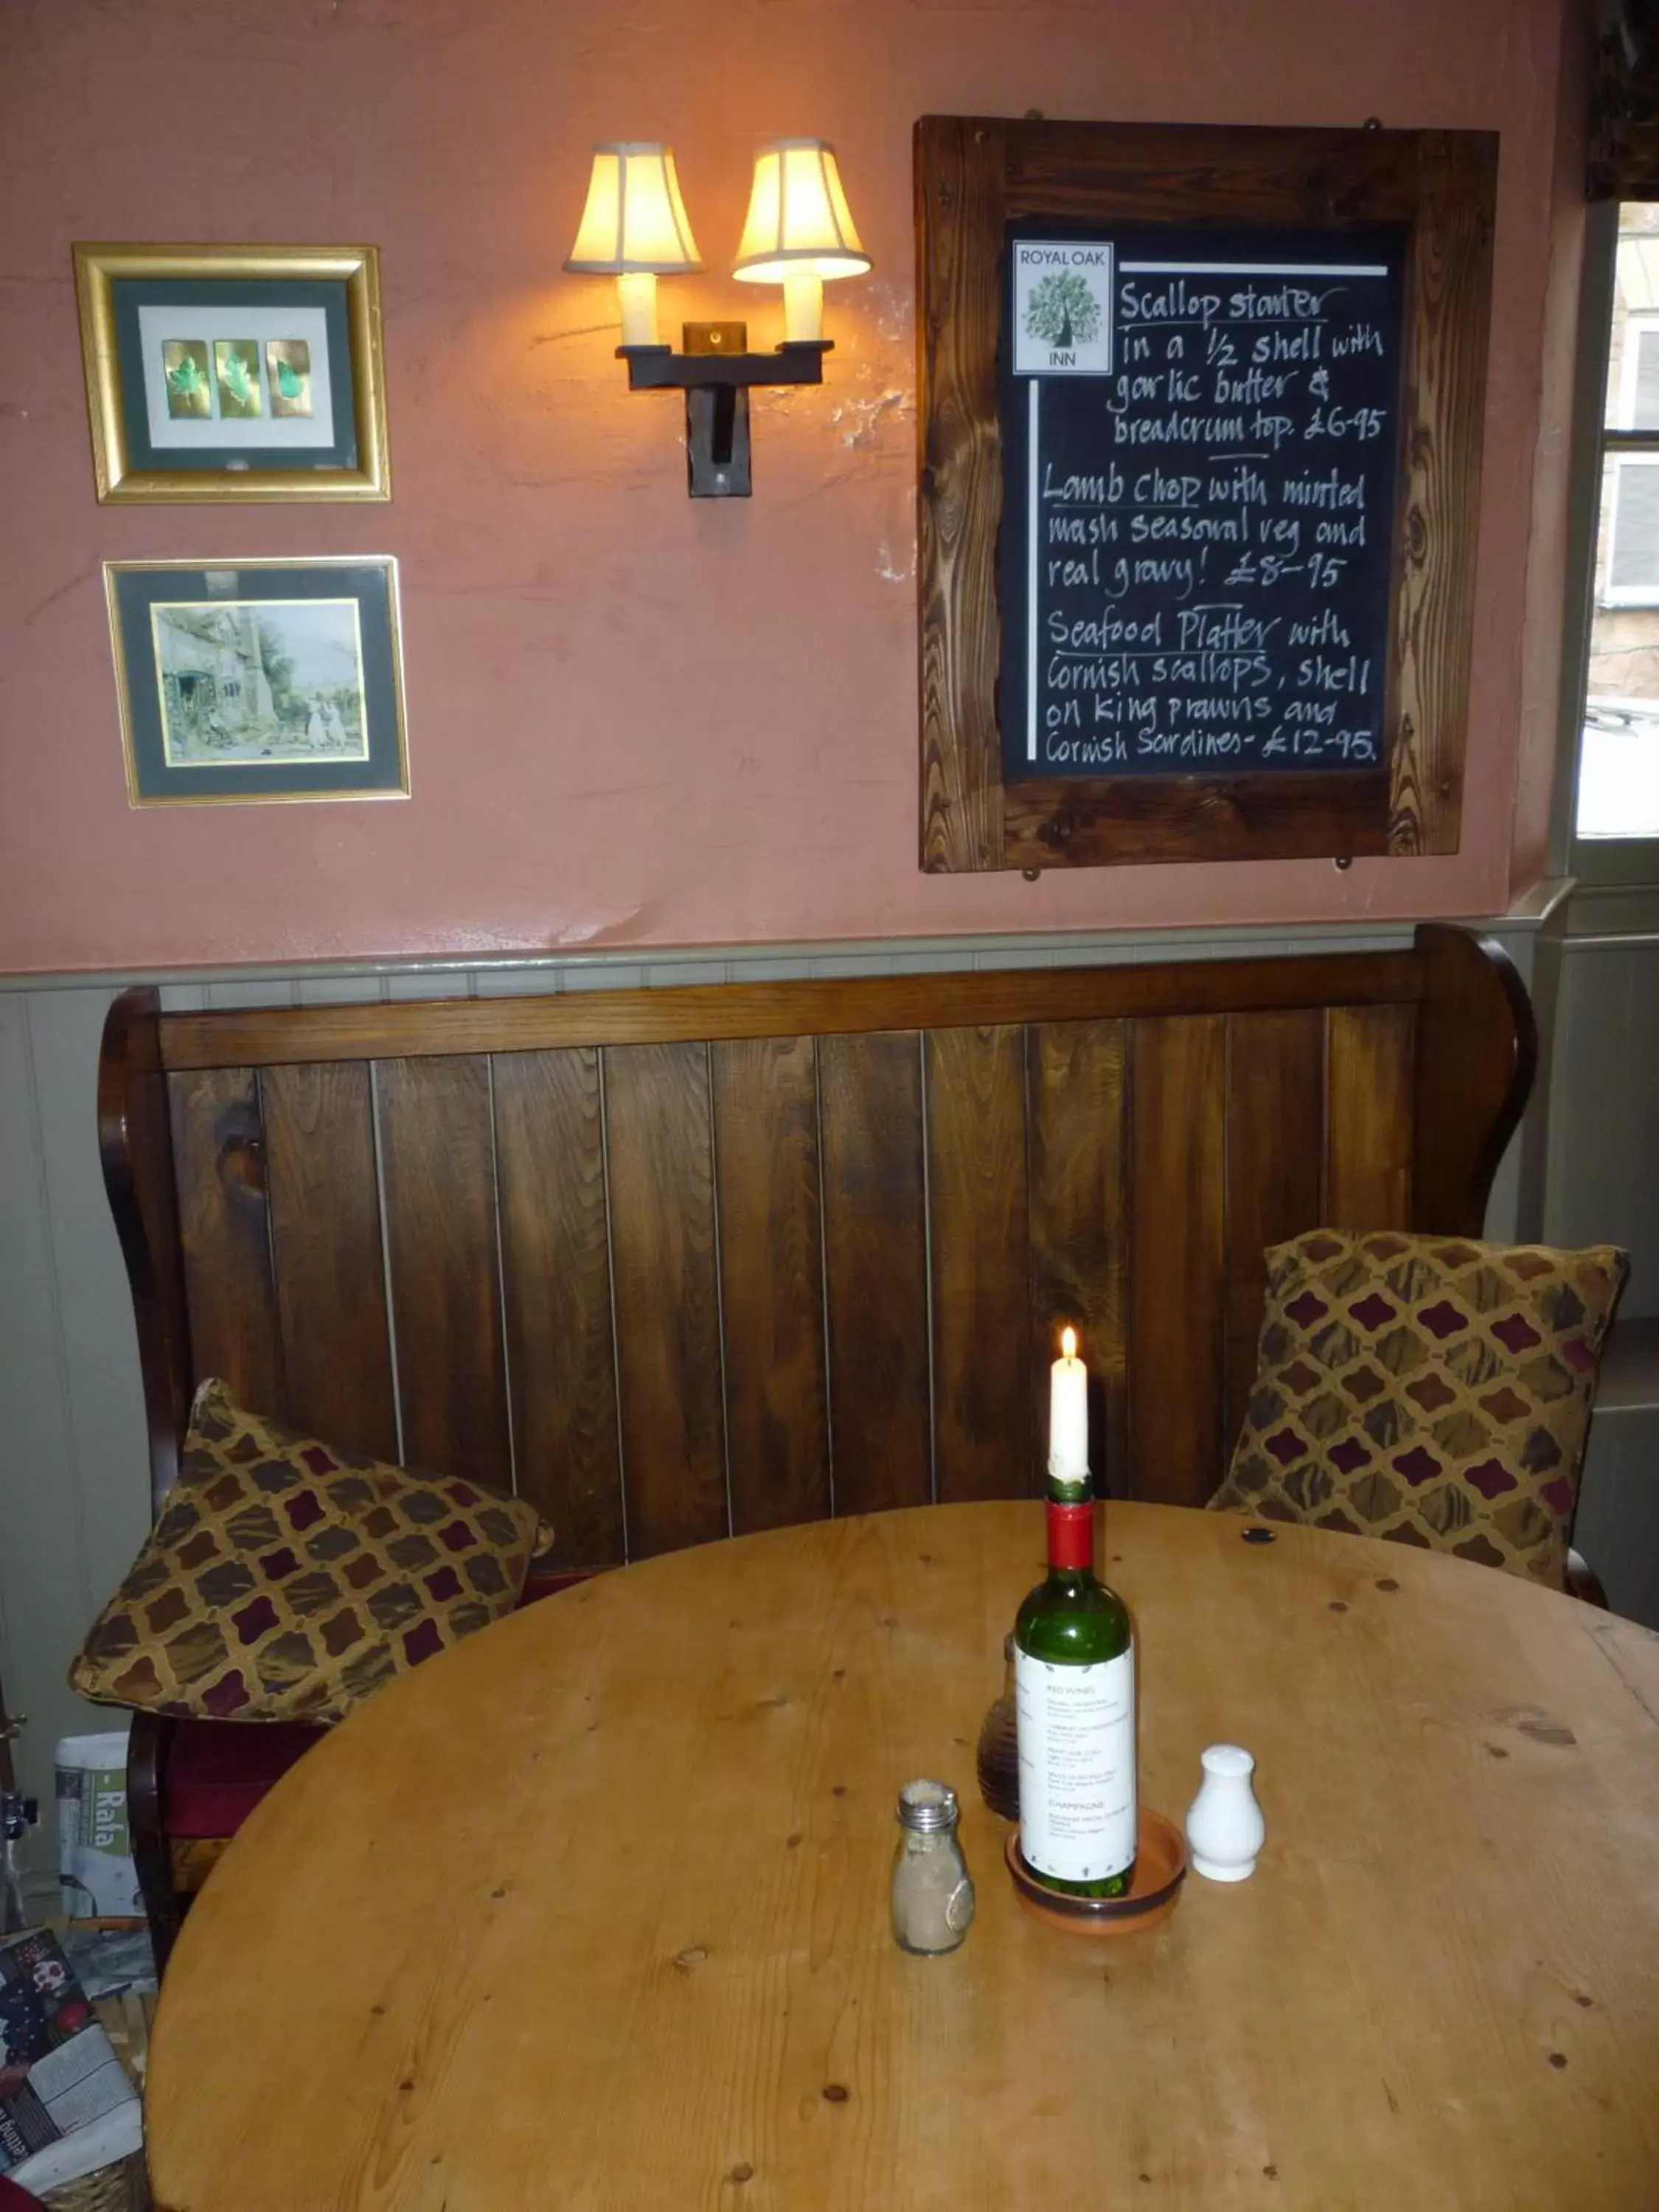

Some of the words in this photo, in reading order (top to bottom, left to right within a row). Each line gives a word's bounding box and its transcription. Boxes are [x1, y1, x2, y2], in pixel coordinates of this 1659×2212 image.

[1020, 250, 1069, 265] ROYAL
[1071, 251, 1105, 266] OAK
[1120, 279, 1221, 330] Scallop
[1229, 284, 1348, 319] starter
[1049, 352, 1077, 366] INN
[1124, 324, 1150, 364] in
[1166, 335, 1184, 360] a
[1251, 324, 1322, 363] shell
[1332, 322, 1383, 358] with
[1107, 368, 1202, 414] garlic
[1214, 366, 1299, 406] butter
[1114, 408, 1246, 445] breadcrum
[1043, 460, 1124, 504] Lamb
[1209, 465, 1267, 506] with
[1283, 467, 1365, 509] minted
[1049, 513, 1119, 546] mash
[1260, 518, 1300, 558] veg
[1316, 515, 1366, 547] and
[1049, 548, 1099, 587] real
[1105, 545, 1208, 601] gravy!
[1048, 604, 1162, 650] Seafood
[1178, 611, 1281, 652] Platter
[1289, 608, 1350, 649] with
[1048, 653, 1140, 689] Cornish
[1298, 655, 1371, 695] shell
[1046, 698, 1080, 728] on
[1169, 695, 1272, 726] prawns
[1284, 700, 1338, 726] and
[1046, 731, 1128, 764] Cornish
